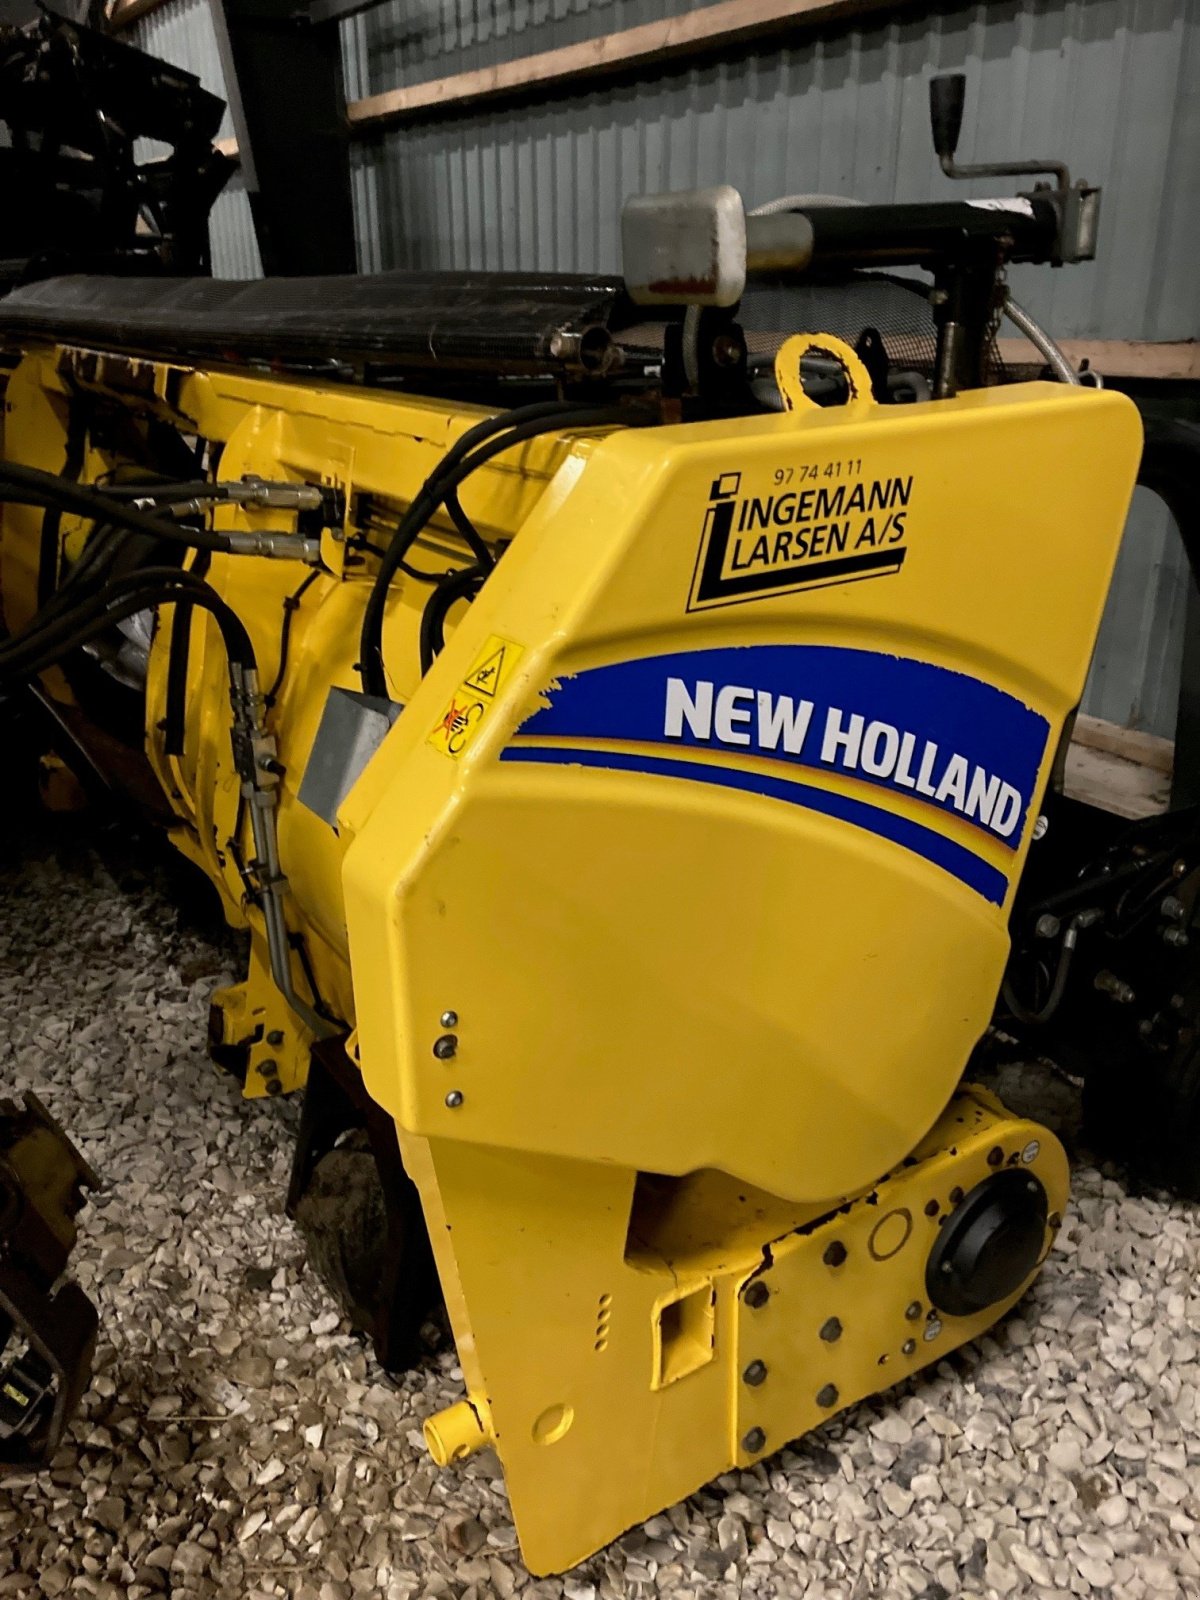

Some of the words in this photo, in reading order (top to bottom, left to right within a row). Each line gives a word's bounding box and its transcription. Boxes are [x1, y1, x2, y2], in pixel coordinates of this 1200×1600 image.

[774, 469, 794, 486] 97
[800, 465, 818, 482] 74
[823, 462, 842, 478] 41
[848, 459, 862, 476] 11
[737, 476, 913, 532] INGEMANN
[731, 521, 850, 571] LARSEN
[854, 512, 907, 549] A/S
[664, 677, 814, 754] NEW
[820, 707, 1022, 837] HOLLAND
